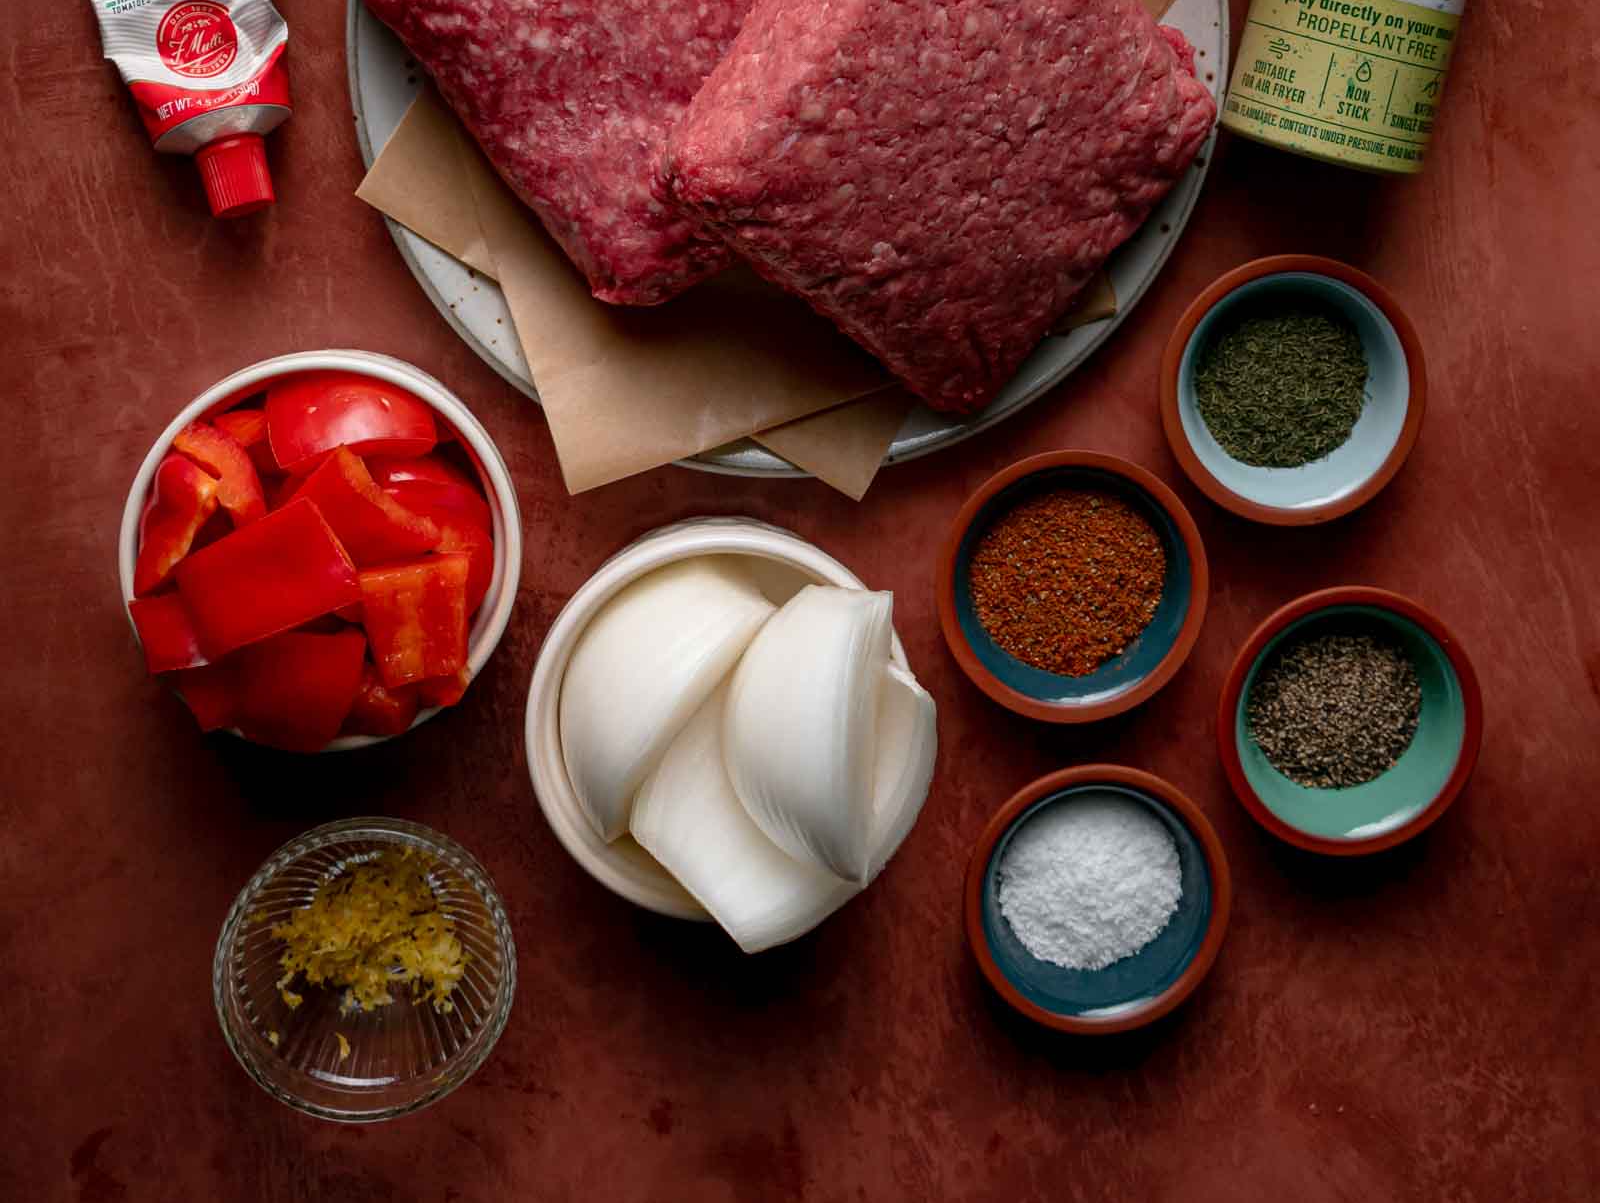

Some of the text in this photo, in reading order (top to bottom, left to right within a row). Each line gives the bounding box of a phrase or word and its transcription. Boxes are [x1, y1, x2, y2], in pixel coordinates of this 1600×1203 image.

[1296, 11, 1405, 55] PROPELLANT
[1407, 40, 1438, 60] FREE
[1385, 14, 1403, 29] on
[1407, 20, 1436, 37] your
[1253, 59, 1296, 84] SUITABLE
[1255, 78, 1271, 95] AIR
[1271, 83, 1306, 104] FRYER
[1346, 84, 1371, 103] NON
[1337, 101, 1371, 122] STICK
[1279, 117, 1319, 138] CONTENTS
[1319, 129, 1346, 146] UNDER
